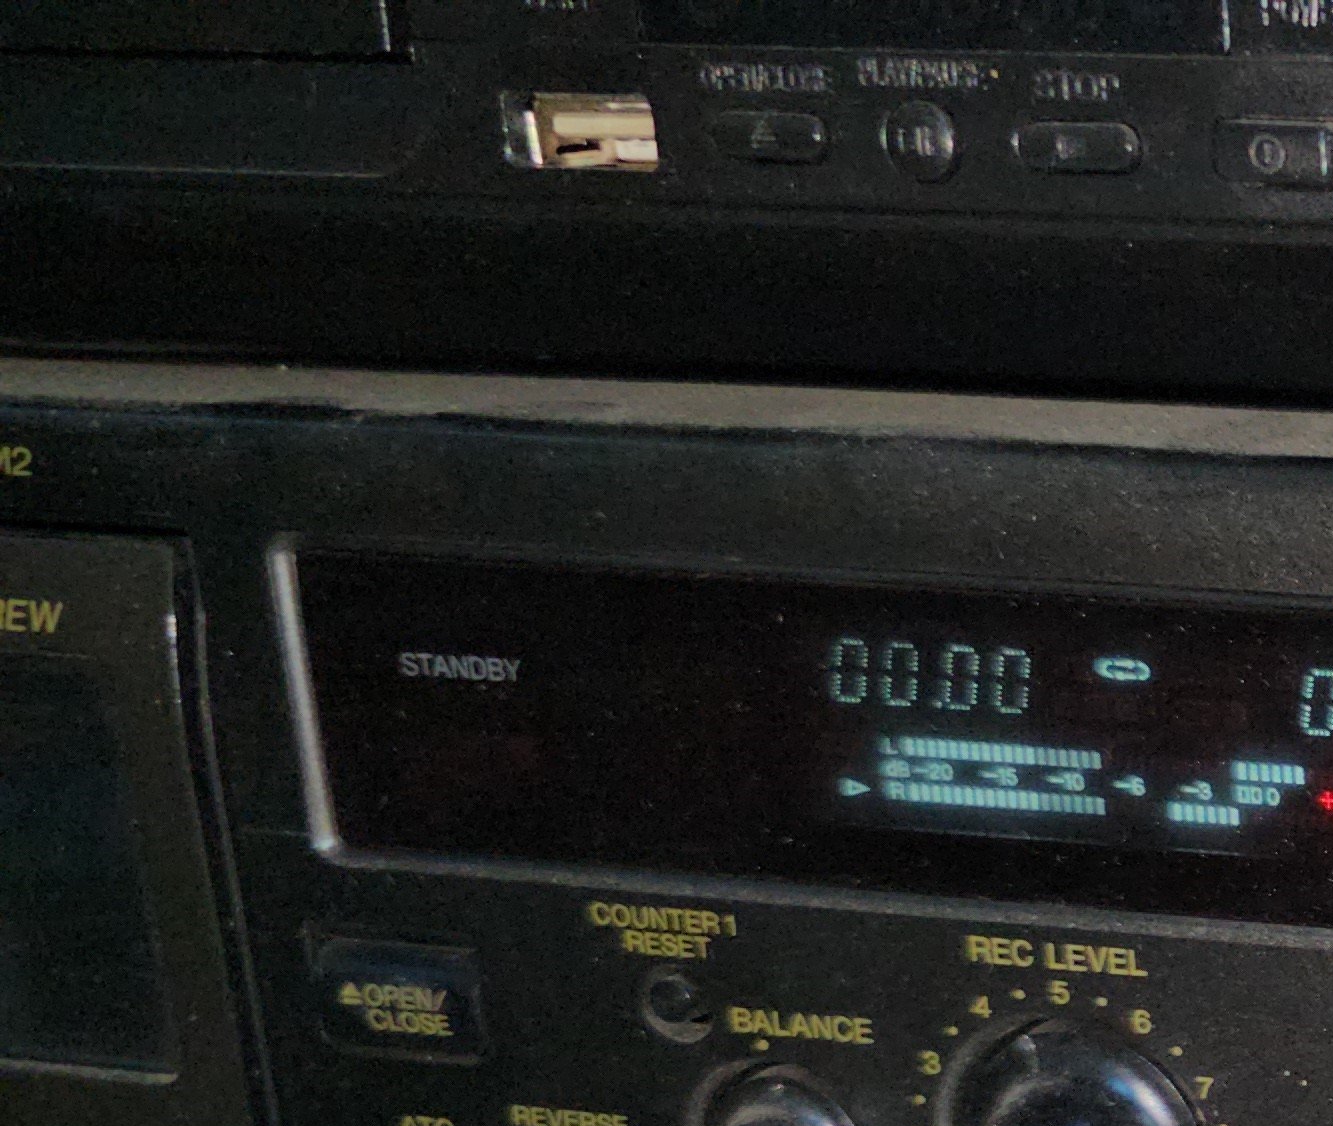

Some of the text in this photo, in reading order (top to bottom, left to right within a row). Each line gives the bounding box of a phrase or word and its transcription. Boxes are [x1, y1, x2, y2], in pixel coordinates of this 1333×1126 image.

[1033, 68, 1120, 101] STOP
[400, 651, 521, 682] STANDBY
[588, 902, 719, 934] COUNTER
[621, 931, 711, 958] RESET
[966, 935, 1149, 976] REC LEVEL
[1049, 981, 1070, 1005] 5
[969, 996, 992, 1018] 4
[367, 1008, 454, 1036] CLOSE
[729, 1006, 874, 1044] BALANCE
[1130, 1010, 1152, 1034] 6
[919, 1051, 941, 1075] 3
[1195, 1076, 1214, 1099] 7
